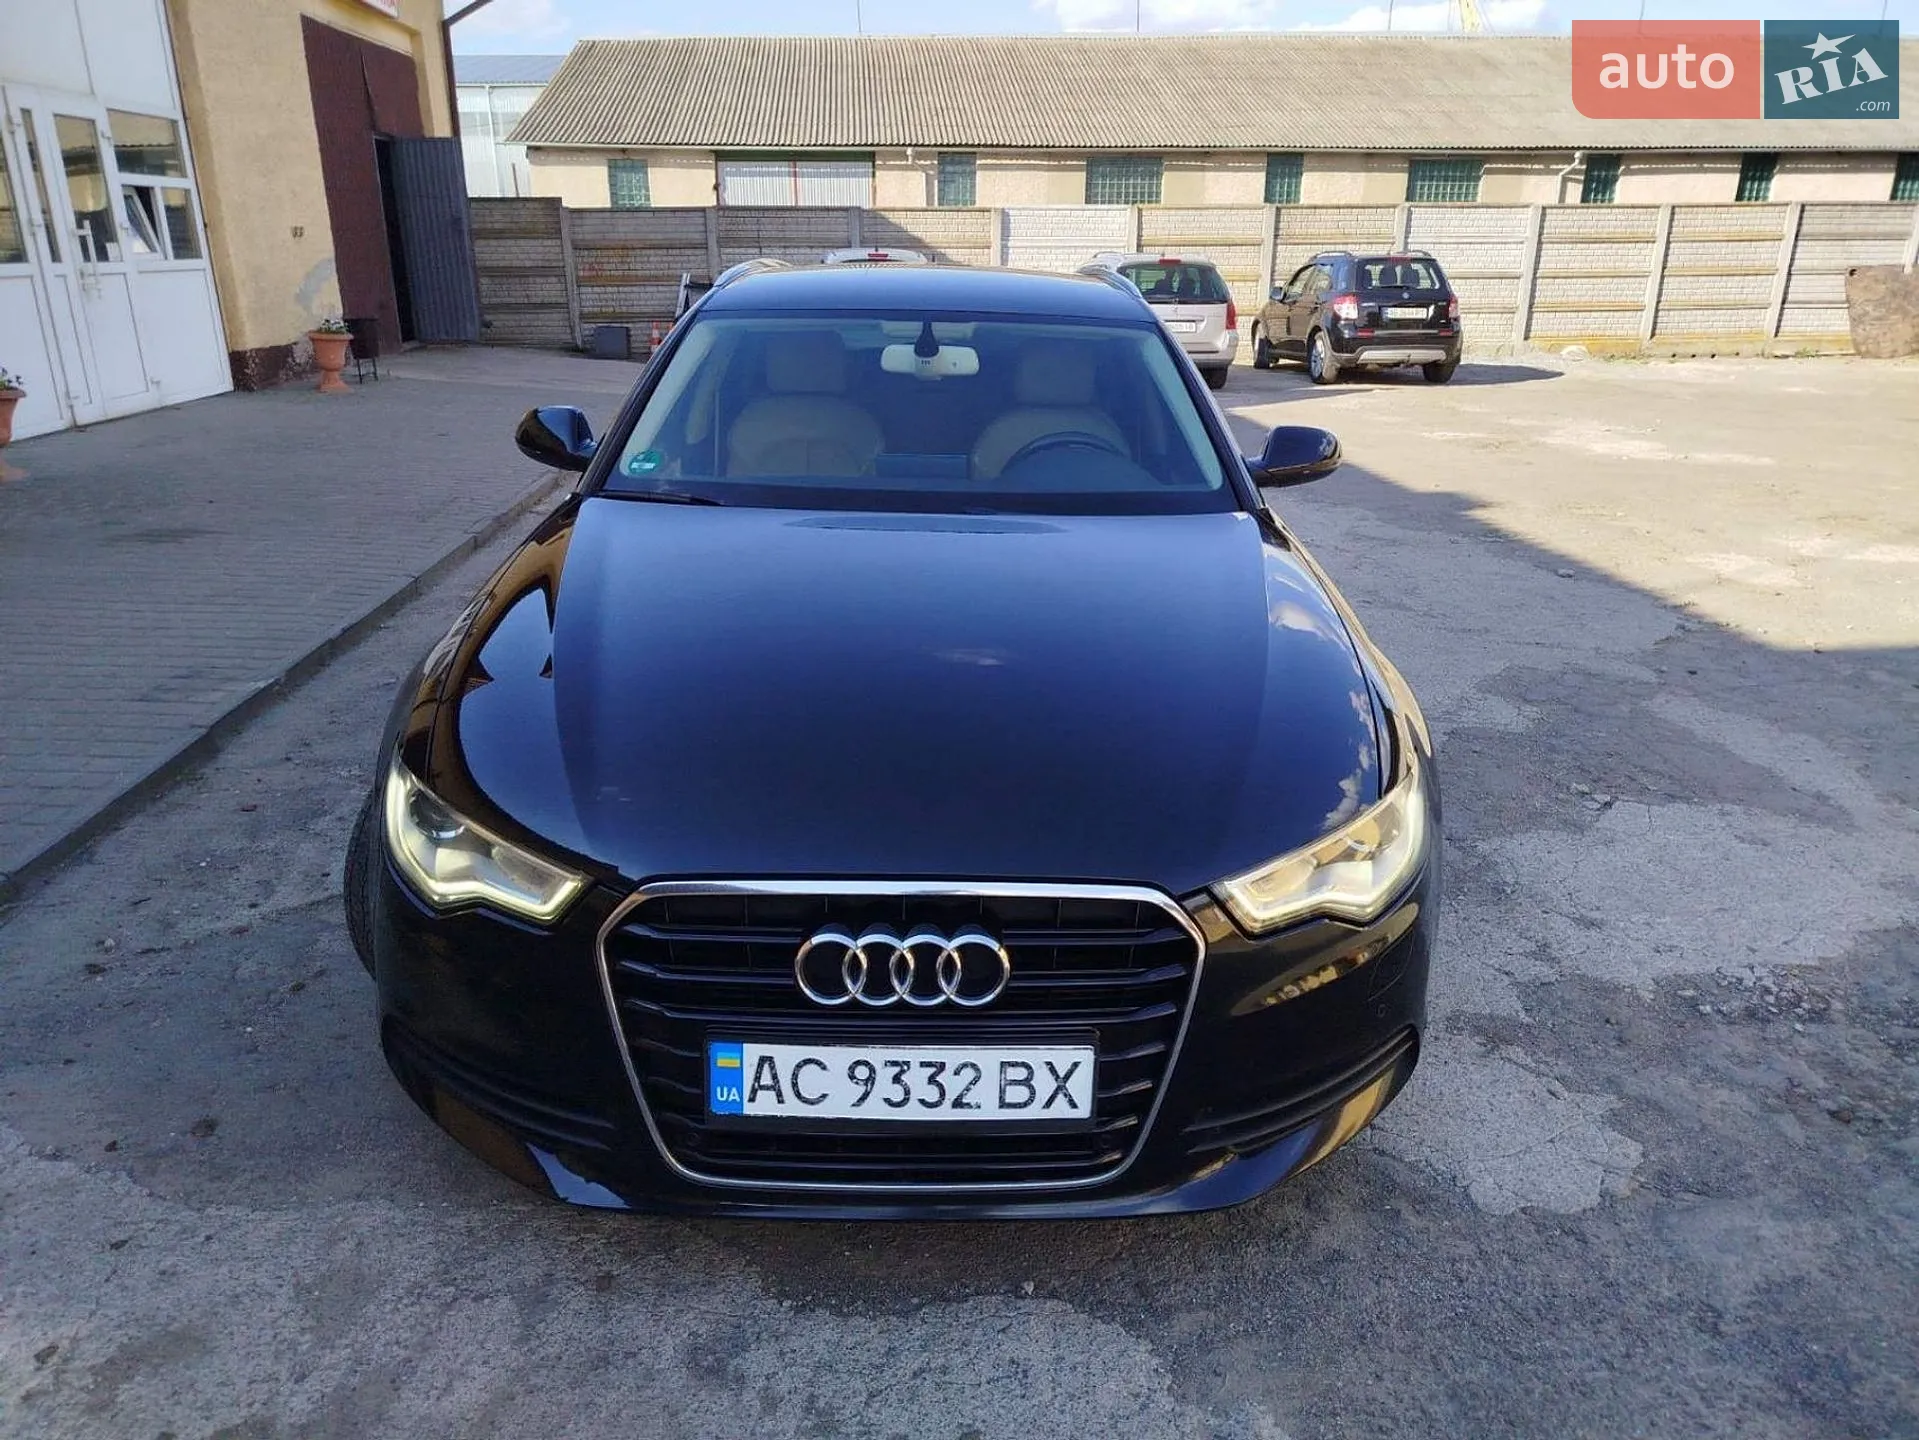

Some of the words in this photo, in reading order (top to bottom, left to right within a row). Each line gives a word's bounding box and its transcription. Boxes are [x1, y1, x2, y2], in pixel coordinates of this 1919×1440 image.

[716, 1086, 741, 1102] UA
[747, 1054, 830, 1106] AC
[847, 1058, 984, 1110] 9332
[998, 1060, 1083, 1110] BX
